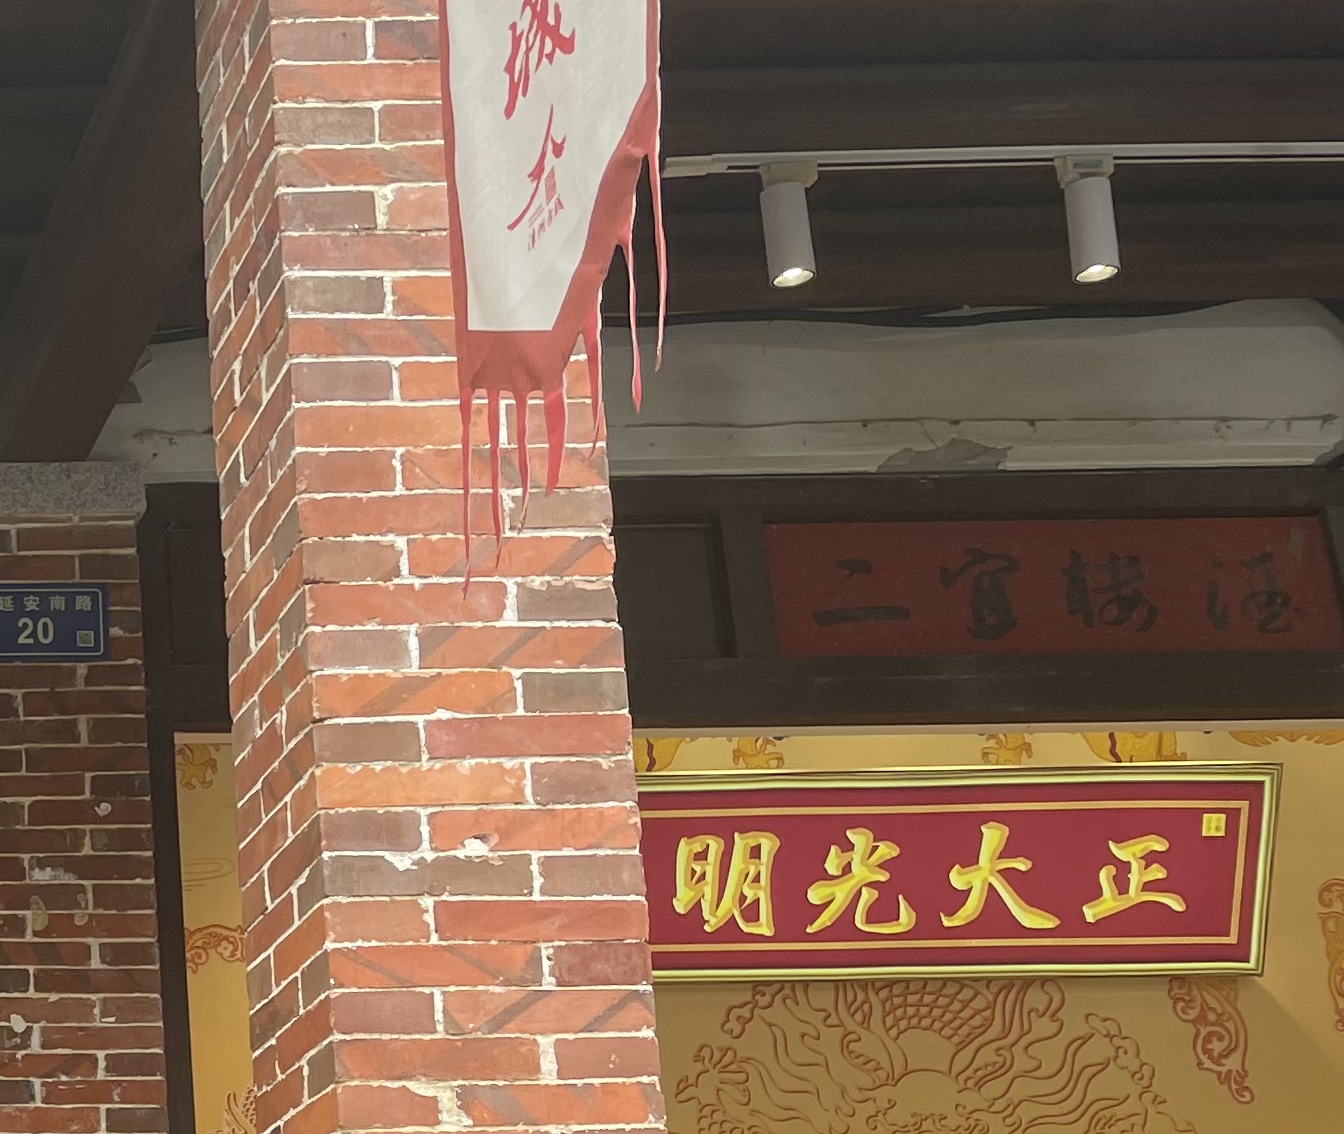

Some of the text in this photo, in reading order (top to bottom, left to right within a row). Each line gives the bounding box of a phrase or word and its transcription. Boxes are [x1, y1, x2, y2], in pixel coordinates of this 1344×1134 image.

[17, 617, 54, 645] 20
[672, 821, 1187, 937] 正大光明
